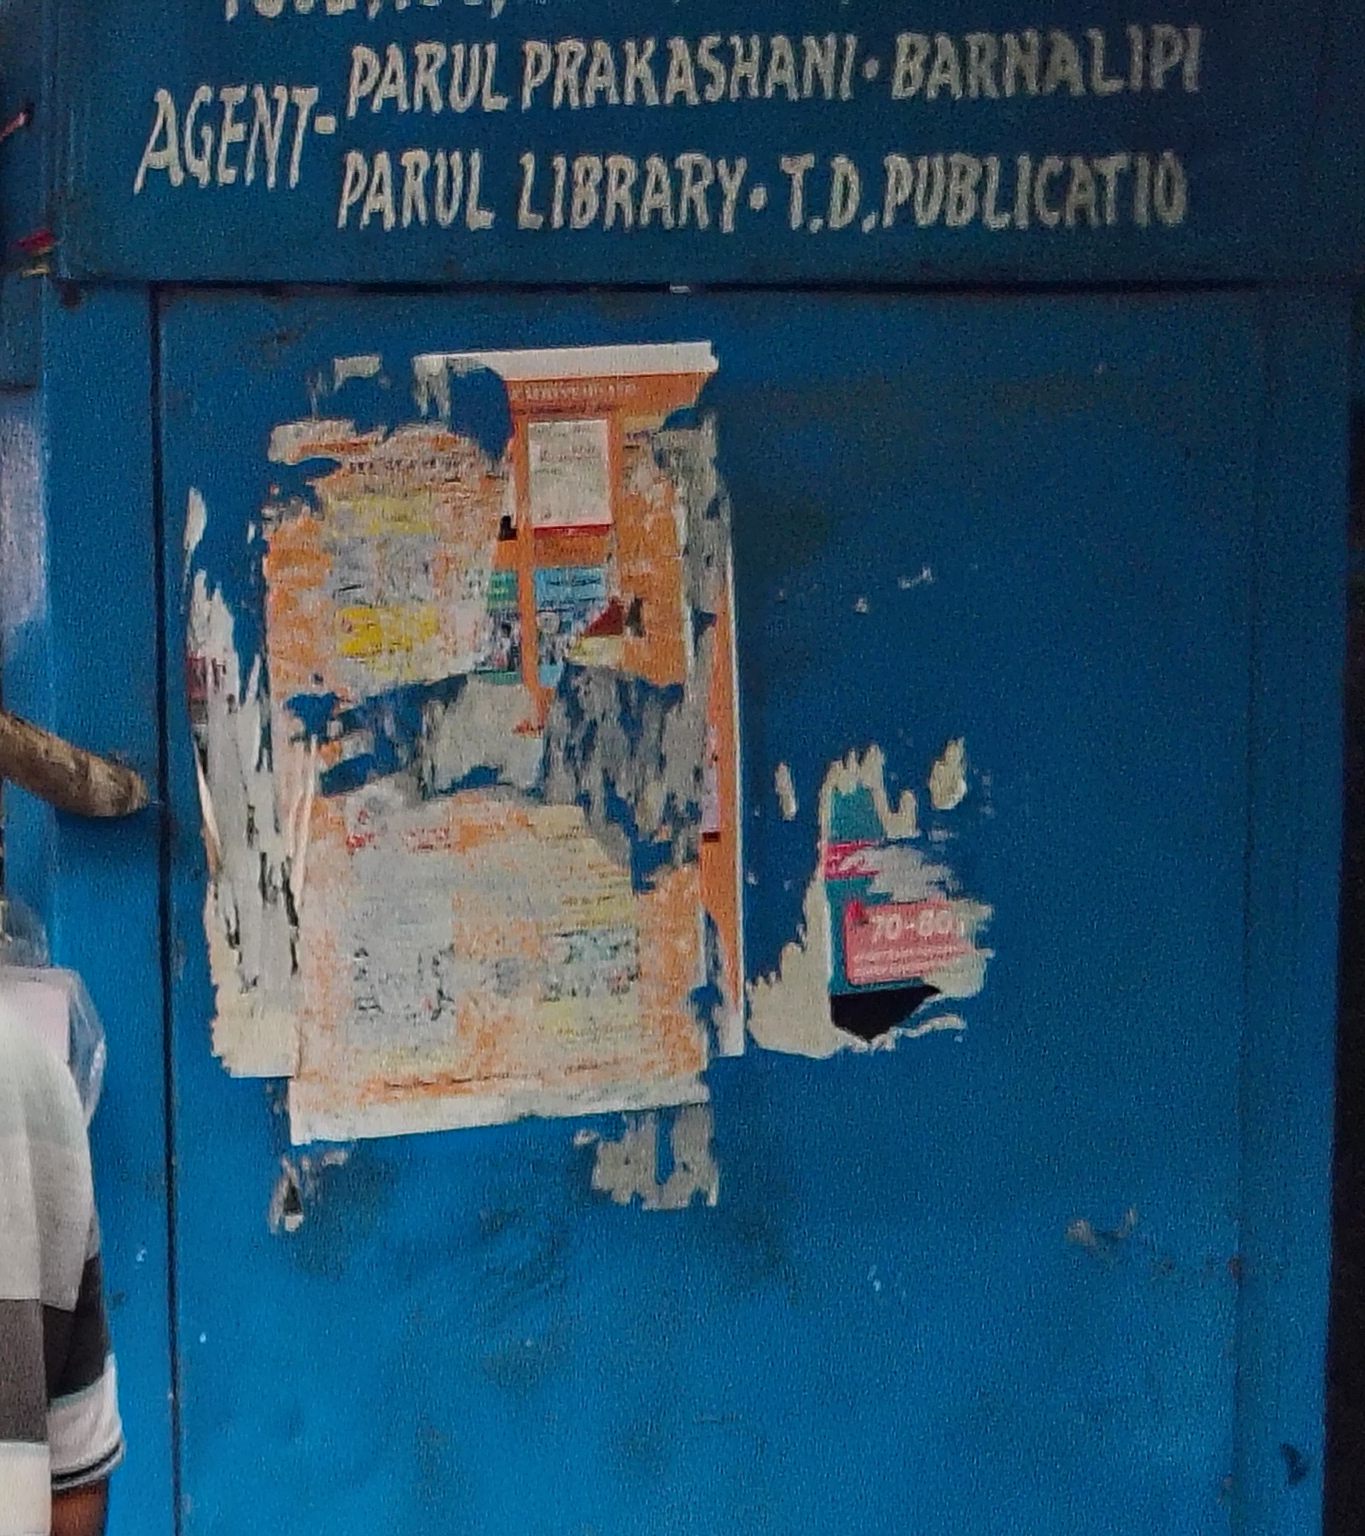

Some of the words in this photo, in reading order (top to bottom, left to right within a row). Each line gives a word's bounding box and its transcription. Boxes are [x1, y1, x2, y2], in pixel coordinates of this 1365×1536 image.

[346, 41, 509, 118] PARUL
[521, 34, 857, 110] PRAKASHANI
[891, 24, 1201, 100] BARNALIPI
[337, 148, 495, 231] PARUL
[517, 151, 747, 234] LIBRARY
